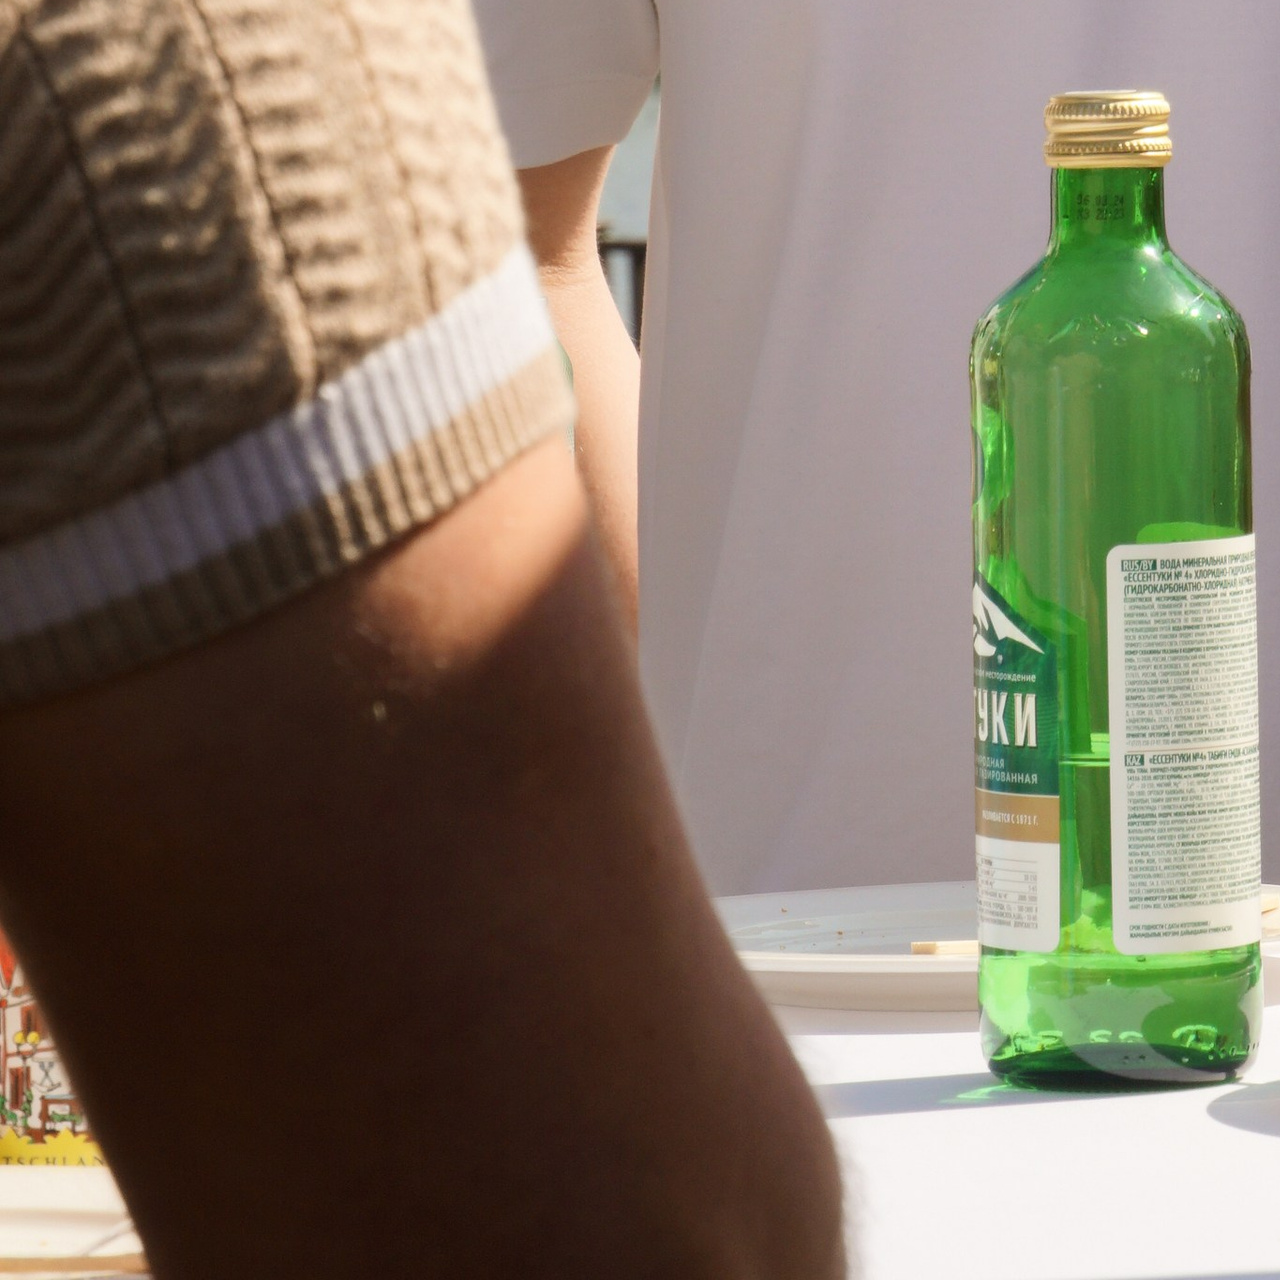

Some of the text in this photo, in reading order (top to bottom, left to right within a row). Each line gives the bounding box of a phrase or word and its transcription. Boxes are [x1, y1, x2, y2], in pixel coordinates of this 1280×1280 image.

[1122, 559, 1154, 572] RUS/BY
[1160, 558, 1181, 570] ВОДА
[1182, 554, 1227, 568] МИНЕРАЛЬНАЯ
[1123, 570, 1172, 582] «ЕССЕНТУКИ
[1126, 755, 1142, 766] KAZ
[1149, 753, 1191, 764] «ЕССЕНТУКИ
